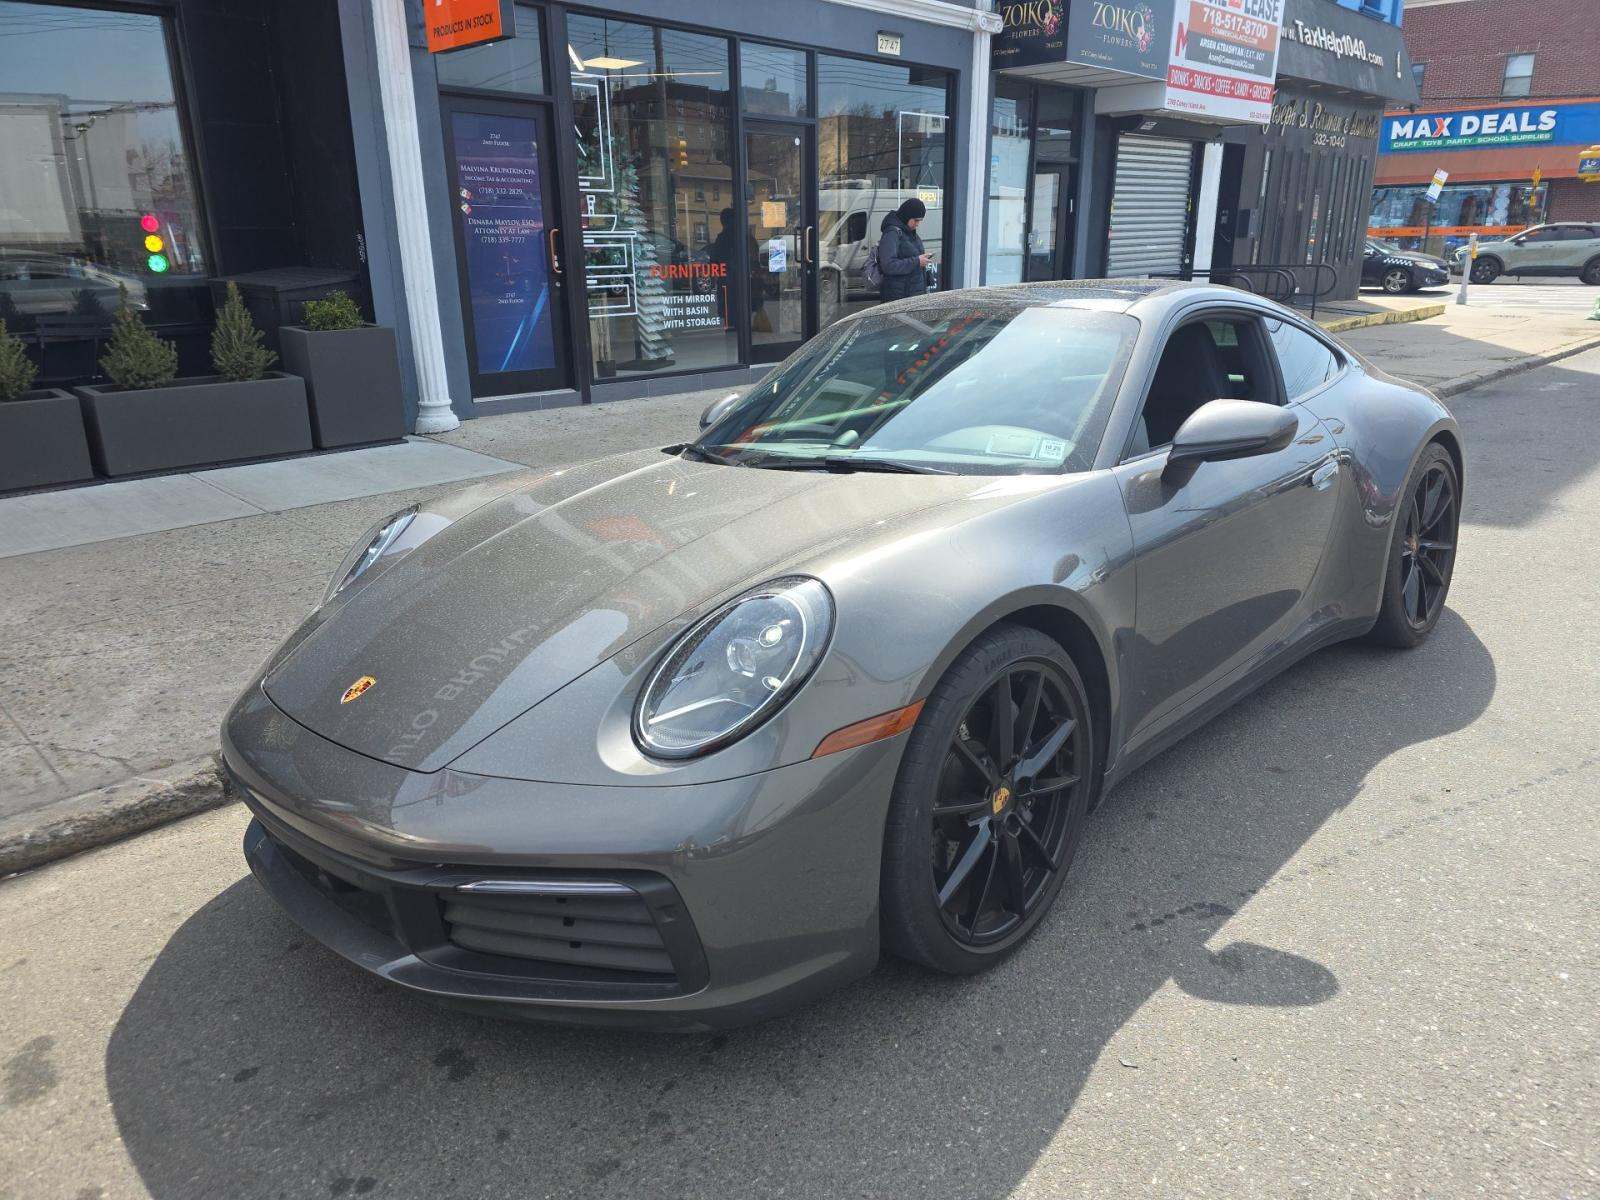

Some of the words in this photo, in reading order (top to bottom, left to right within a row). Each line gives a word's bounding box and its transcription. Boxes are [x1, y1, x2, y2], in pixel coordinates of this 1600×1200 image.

[1002, 0, 1053, 28] ZOIKO
[1244, 0, 1281, 22] LEASE
[433, 20, 464, 39] PRODUCTS
[465, 18, 472, 30] IN
[473, 13, 494, 29] STOCK
[1091, 2, 1145, 41] ZOIKO
[1203, 7, 1268, 40] 718-517-8700
[879, 38, 899, 51] 2747
[1103, 34, 1133, 48] FLOWERS
[1170, 69, 1189, 87] DRINKS
[1193, 73, 1212, 91] SNACKS
[1214, 77, 1232, 95] COFFEE
[1234, 80, 1249, 97] CANDY
[1390, 117, 1454, 140] MAX
[1460, 110, 1558, 136] DEALS
[1313, 132, 1346, 148] 332-1040
[1393, 140, 1419, 148] CRAFT
[1422, 139, 1443, 147] TOYS
[1477, 135, 1511, 143] SCHOOL
[1511, 133, 1551, 142] SUPPLIES
[474, 227, 507, 235] ATTORNEY
[517, 228, 531, 236] LAW
[649, 263, 728, 280] FURNITURE
[662, 295, 684, 305] WITH
[685, 293, 716, 303] MIRROR
[663, 308, 684, 317] WITH
[686, 306, 709, 315] BASIN
[664, 319, 685, 329] WITH
[686, 317, 721, 327] STORAGE
